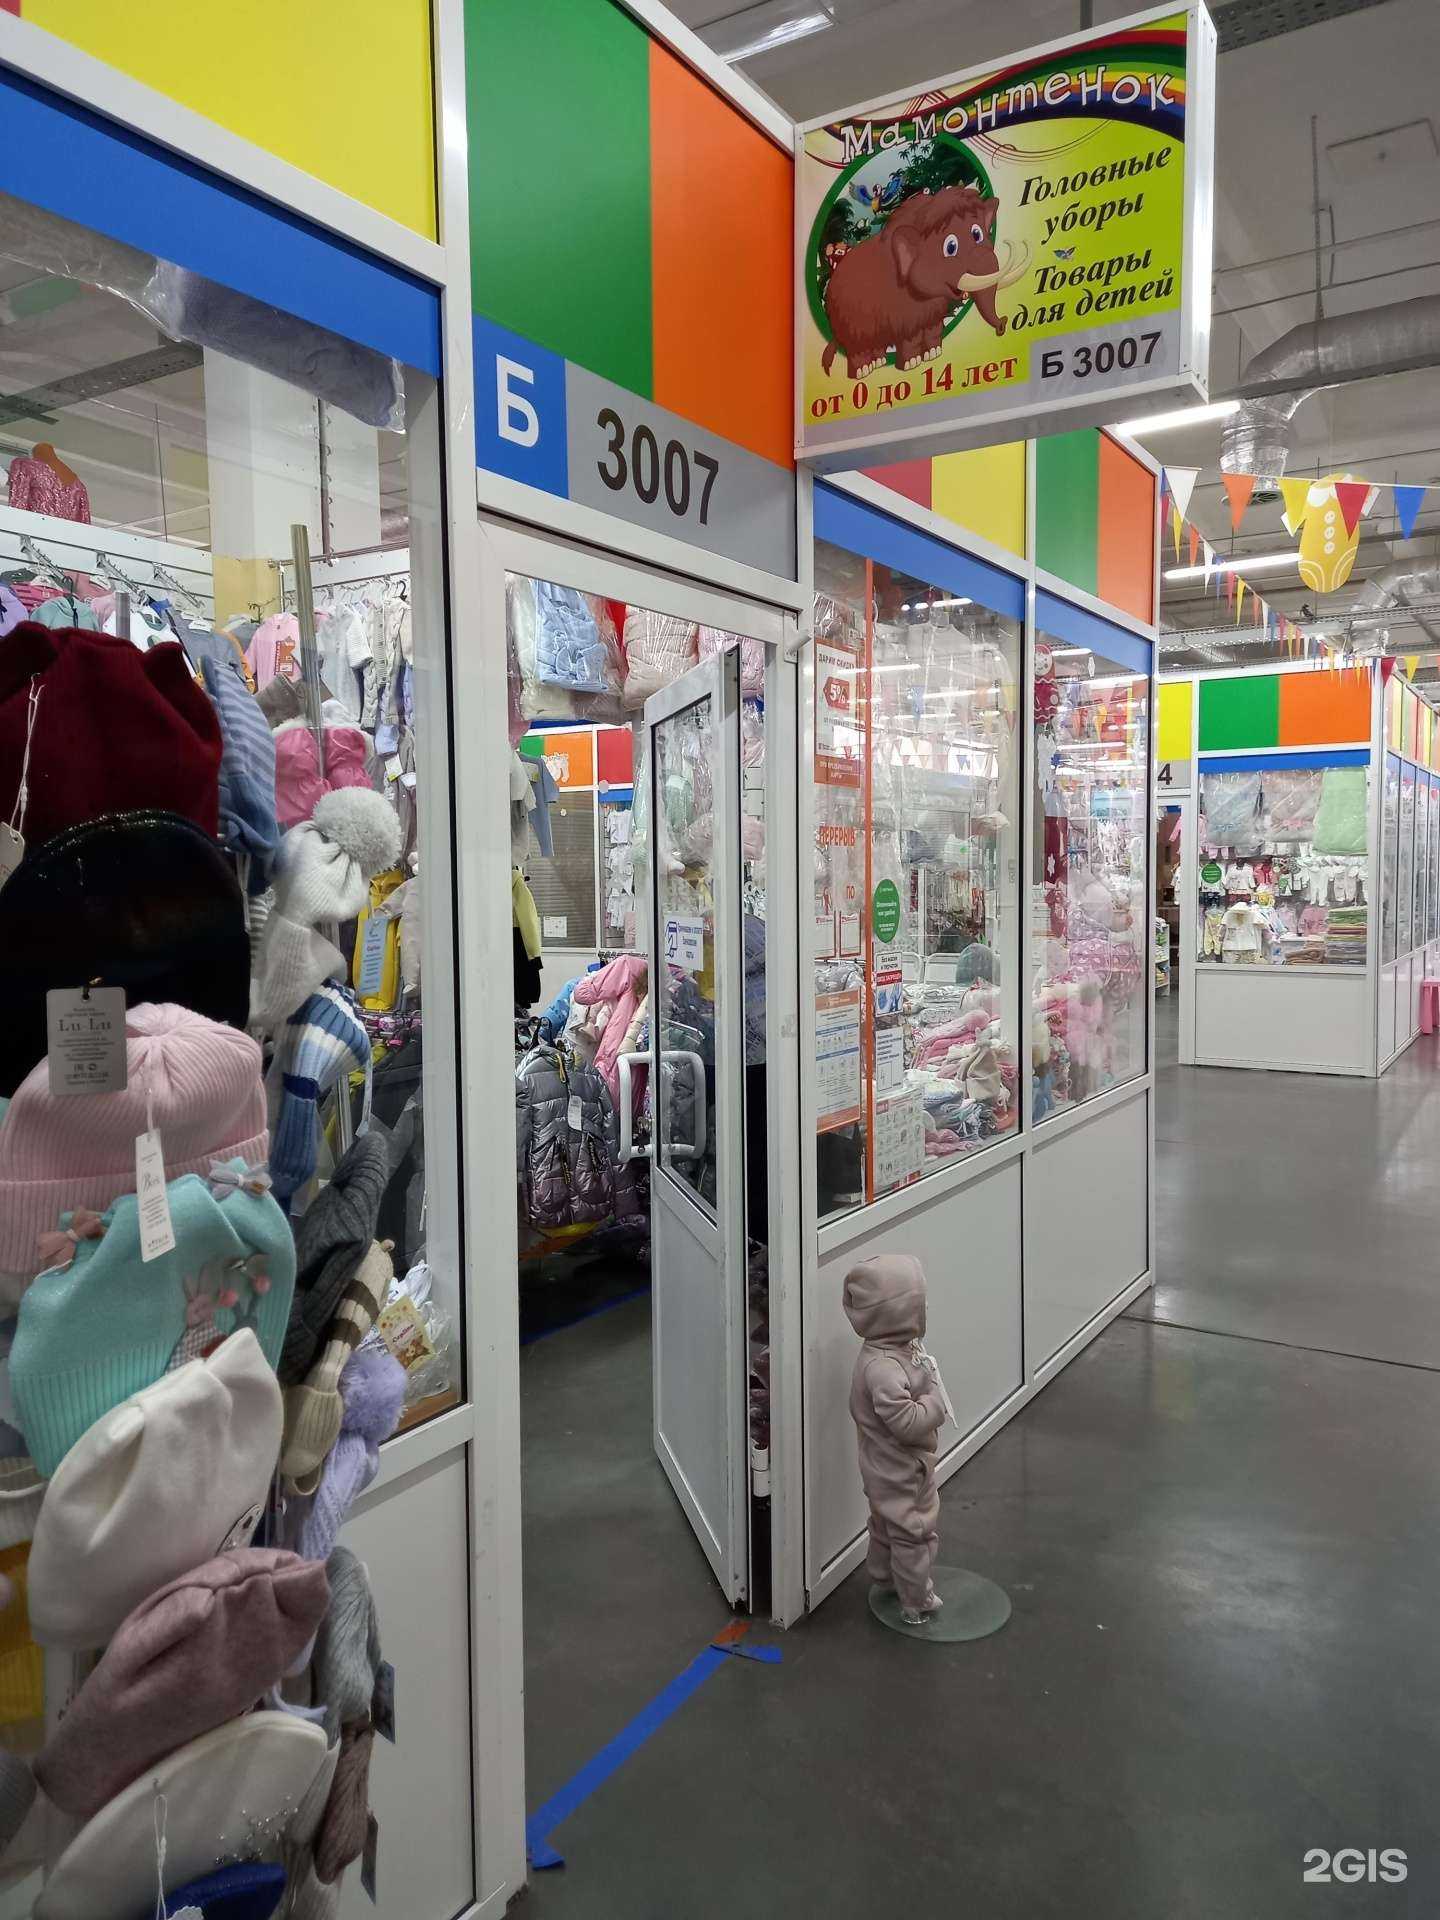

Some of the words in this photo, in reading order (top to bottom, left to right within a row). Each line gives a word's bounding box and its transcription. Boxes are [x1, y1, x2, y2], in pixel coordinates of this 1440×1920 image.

[840, 65, 1176, 164] Мамонтенок
[1018, 146, 1173, 207] Головные
[1040, 193, 1145, 245] уборы
[1011, 303, 1066, 331] для
[1075, 268, 1175, 317] детей
[1034, 249, 1152, 296] Товары
[1041, 350, 1064, 379] Б
[1073, 331, 1162, 379] 3007
[811, 393, 844, 418] от
[852, 381, 869, 410] 0
[876, 380, 912, 415] до
[921, 366, 954, 397] 14
[961, 356, 1019, 388] лет
[496, 354, 540, 448] Б
[597, 407, 719, 526] 3007
[829, 683, 846, 704] 5%
